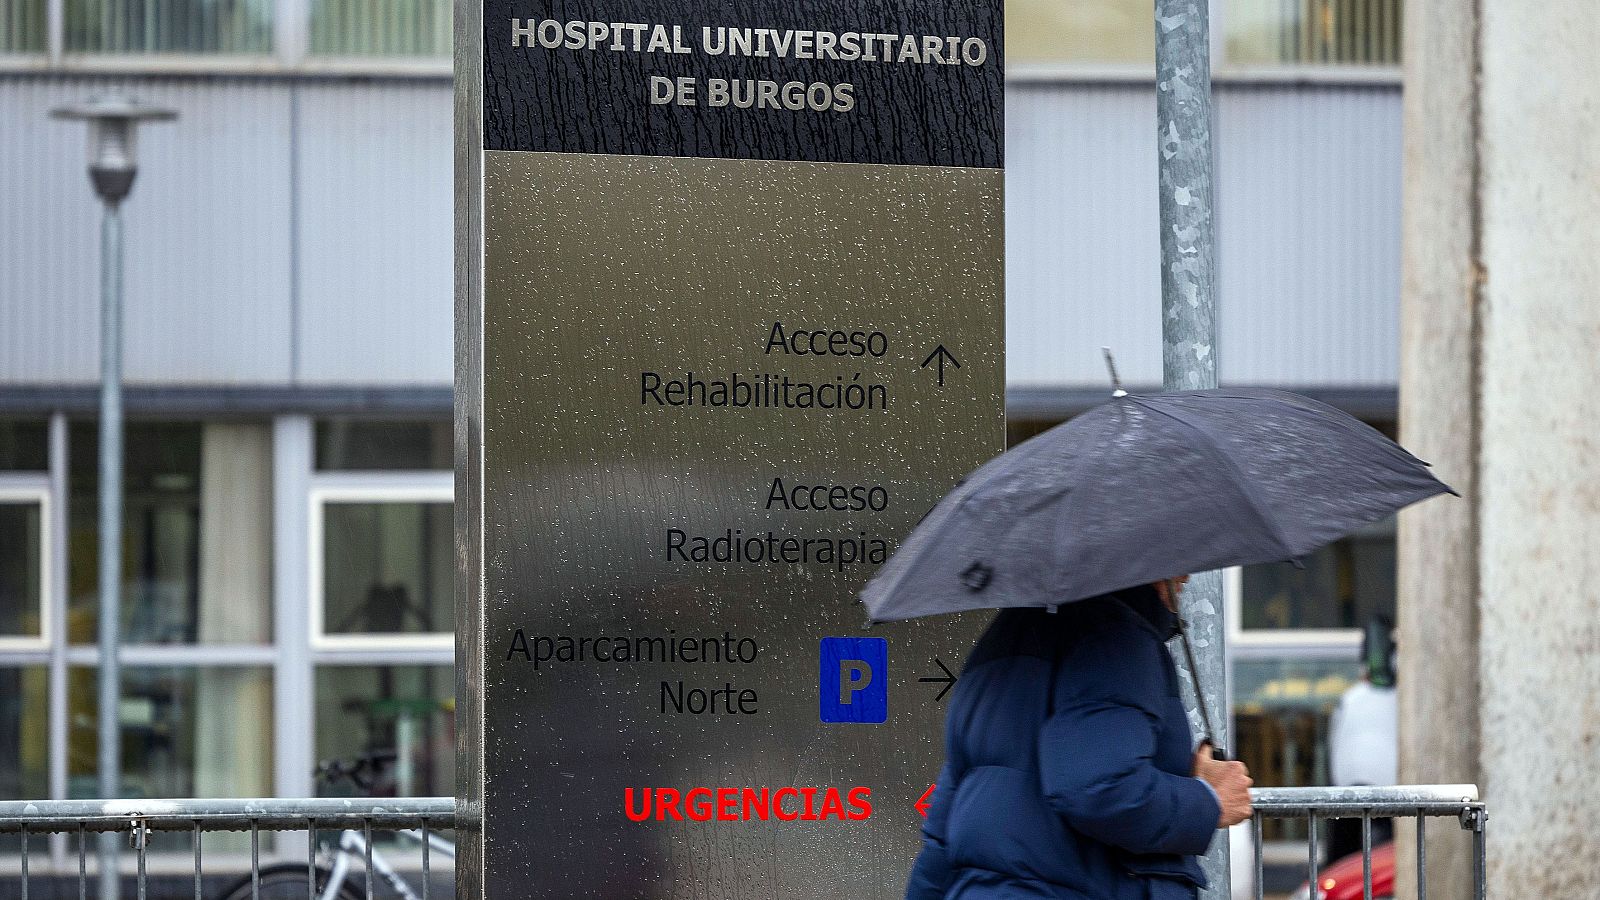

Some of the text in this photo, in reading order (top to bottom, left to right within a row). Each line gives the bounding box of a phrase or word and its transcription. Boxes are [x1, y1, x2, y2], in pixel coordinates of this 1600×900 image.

[511, 18, 988, 68] HOSPITAL UNIVERSITARIO
[649, 76, 855, 113] DE BURGOS
[765, 322, 888, 358] Acceso
[641, 371, 888, 410] Rehabilitación
[765, 476, 889, 512] Acceso
[665, 528, 888, 572] Radioterapia
[506, 627, 759, 670] Aparcamiento
[659, 681, 759, 715] Norte
[839, 659, 873, 705] P
[623, 786, 873, 822] URGENCIAS
